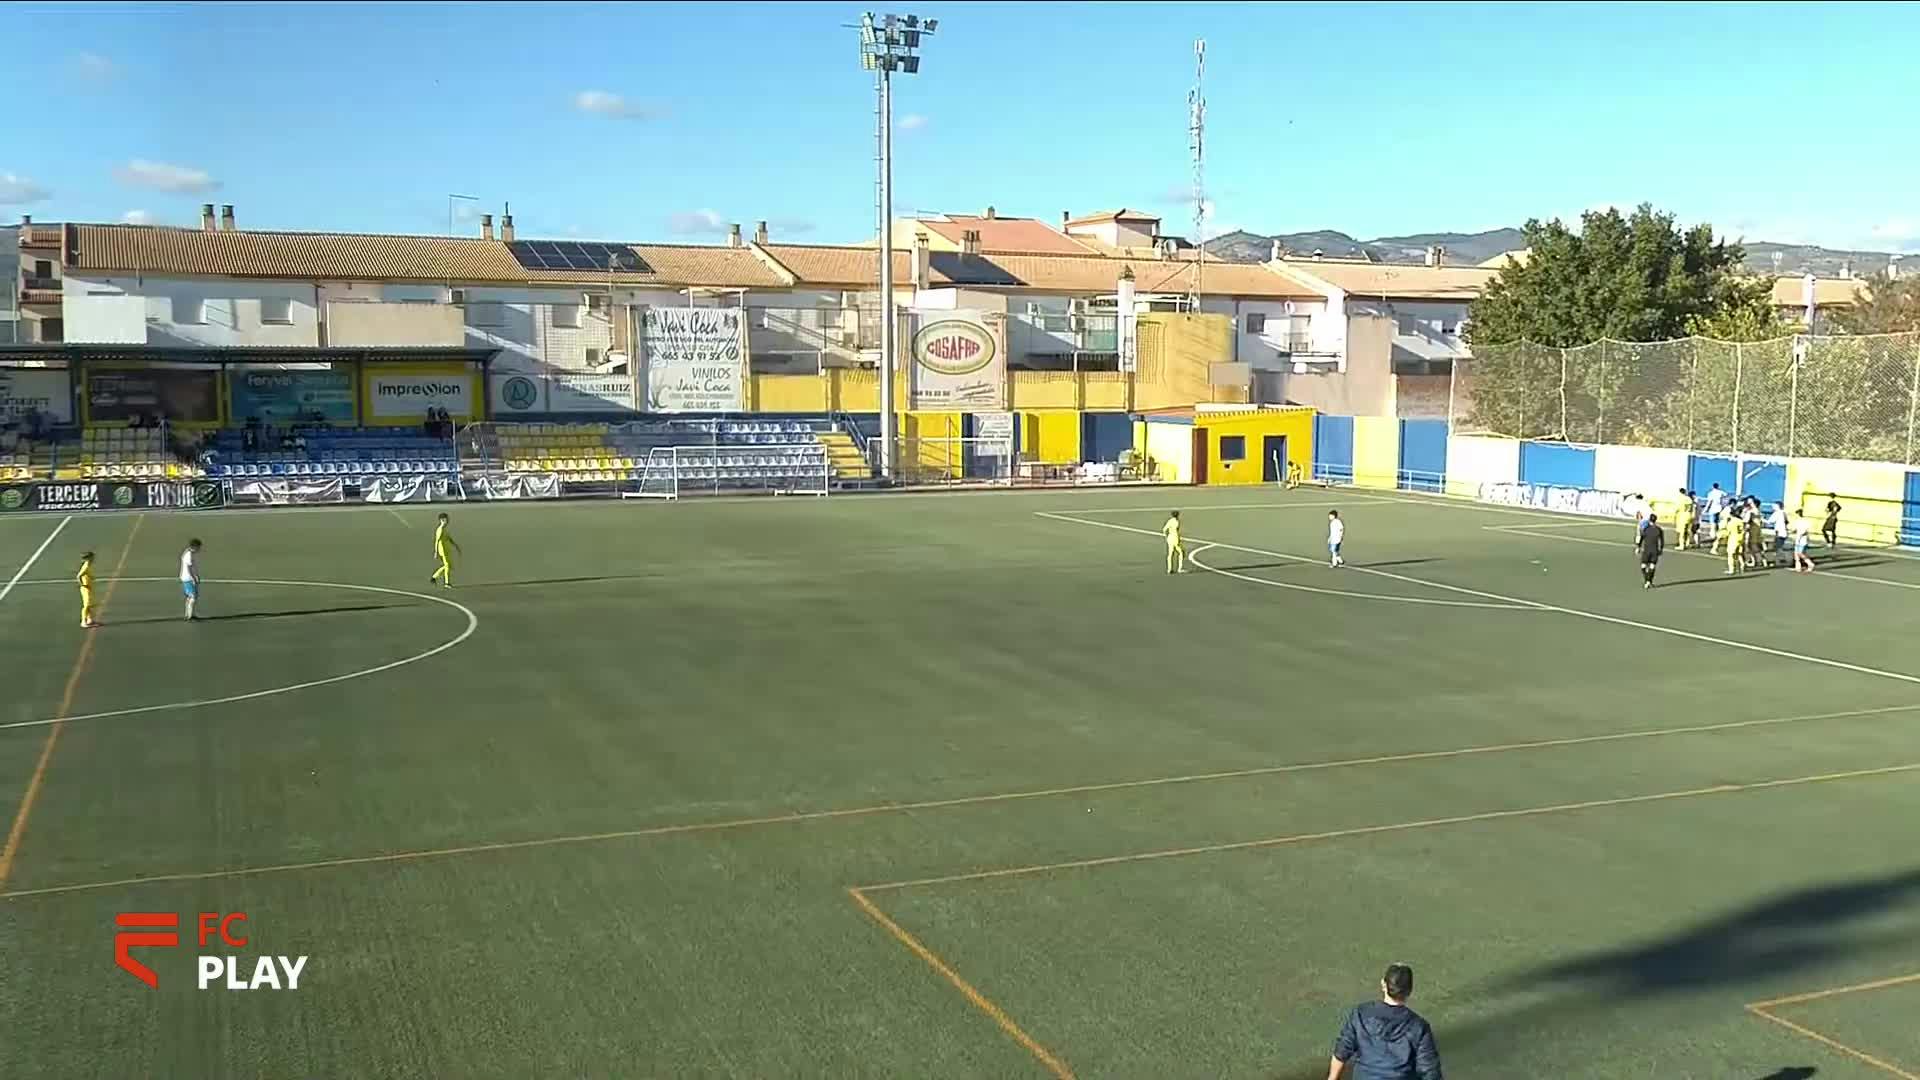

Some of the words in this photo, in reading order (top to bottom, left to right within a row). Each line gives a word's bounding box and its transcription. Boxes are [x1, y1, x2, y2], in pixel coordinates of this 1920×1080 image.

[692, 367, 731, 379] VINILOS
[676, 378, 700, 391] Javi
[704, 378, 731, 392] Coca
[38, 485, 98, 502] TERCERA
